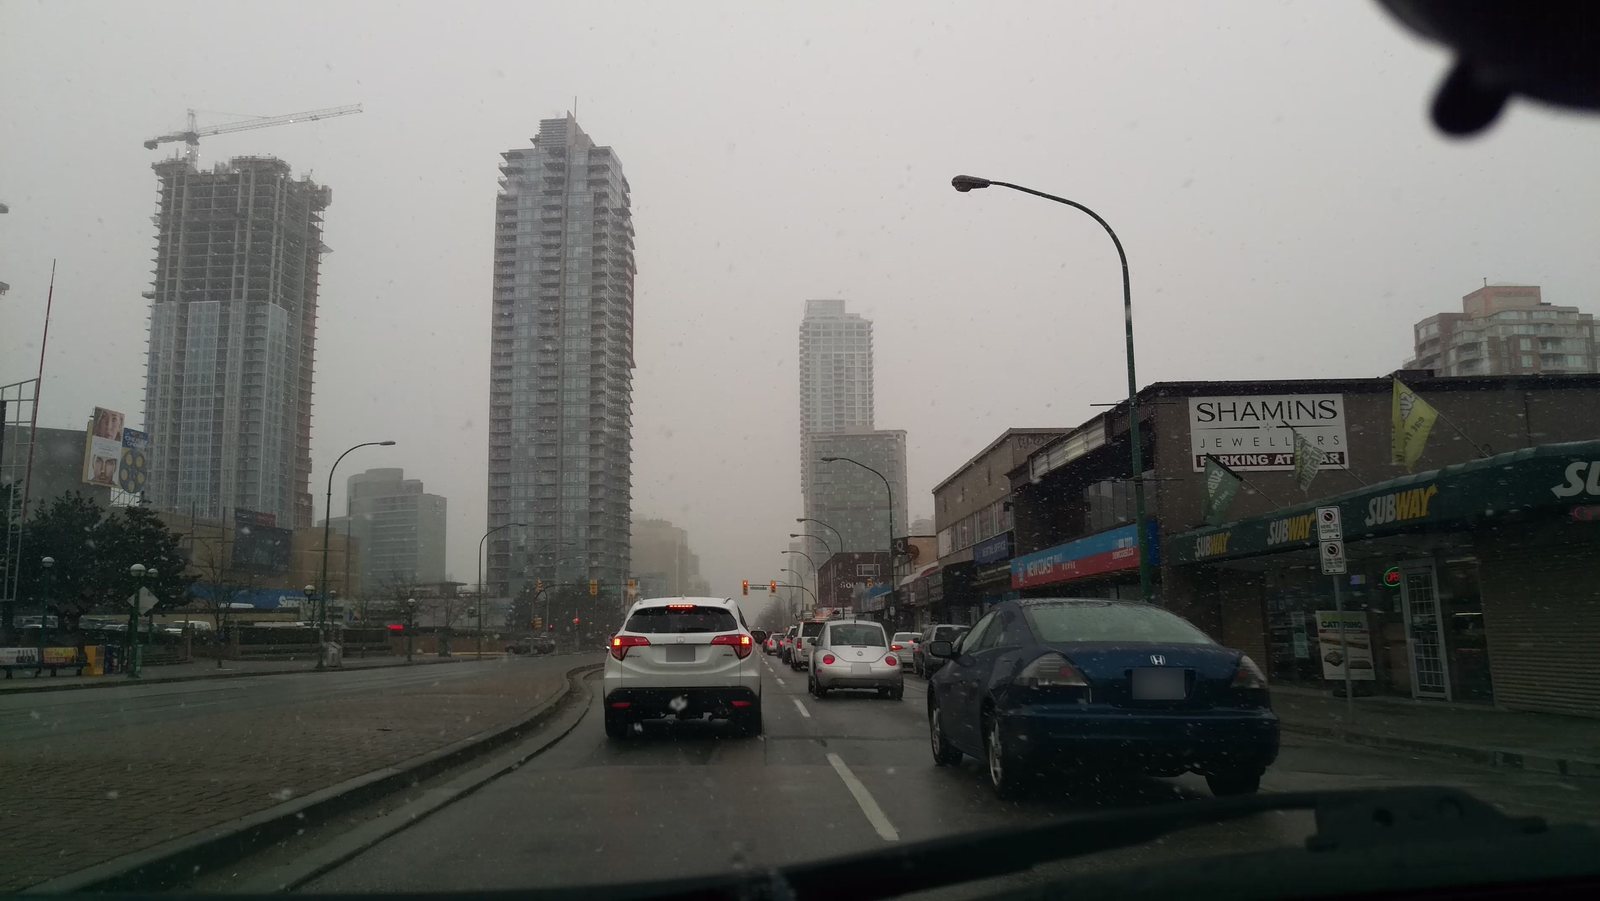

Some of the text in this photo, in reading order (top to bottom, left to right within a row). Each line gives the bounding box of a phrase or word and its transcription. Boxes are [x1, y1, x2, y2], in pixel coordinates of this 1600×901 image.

[1196, 399, 1338, 422] SHAMINS
[1200, 435, 1340, 448] JEWELLRS
[1200, 454, 1269, 466] PRKING
[1274, 453, 1294, 465] AT
[1364, 483, 1439, 527] SUBWAY
[1267, 511, 1316, 545] SUBWAY
[1195, 531, 1231, 561] SUBWAY
